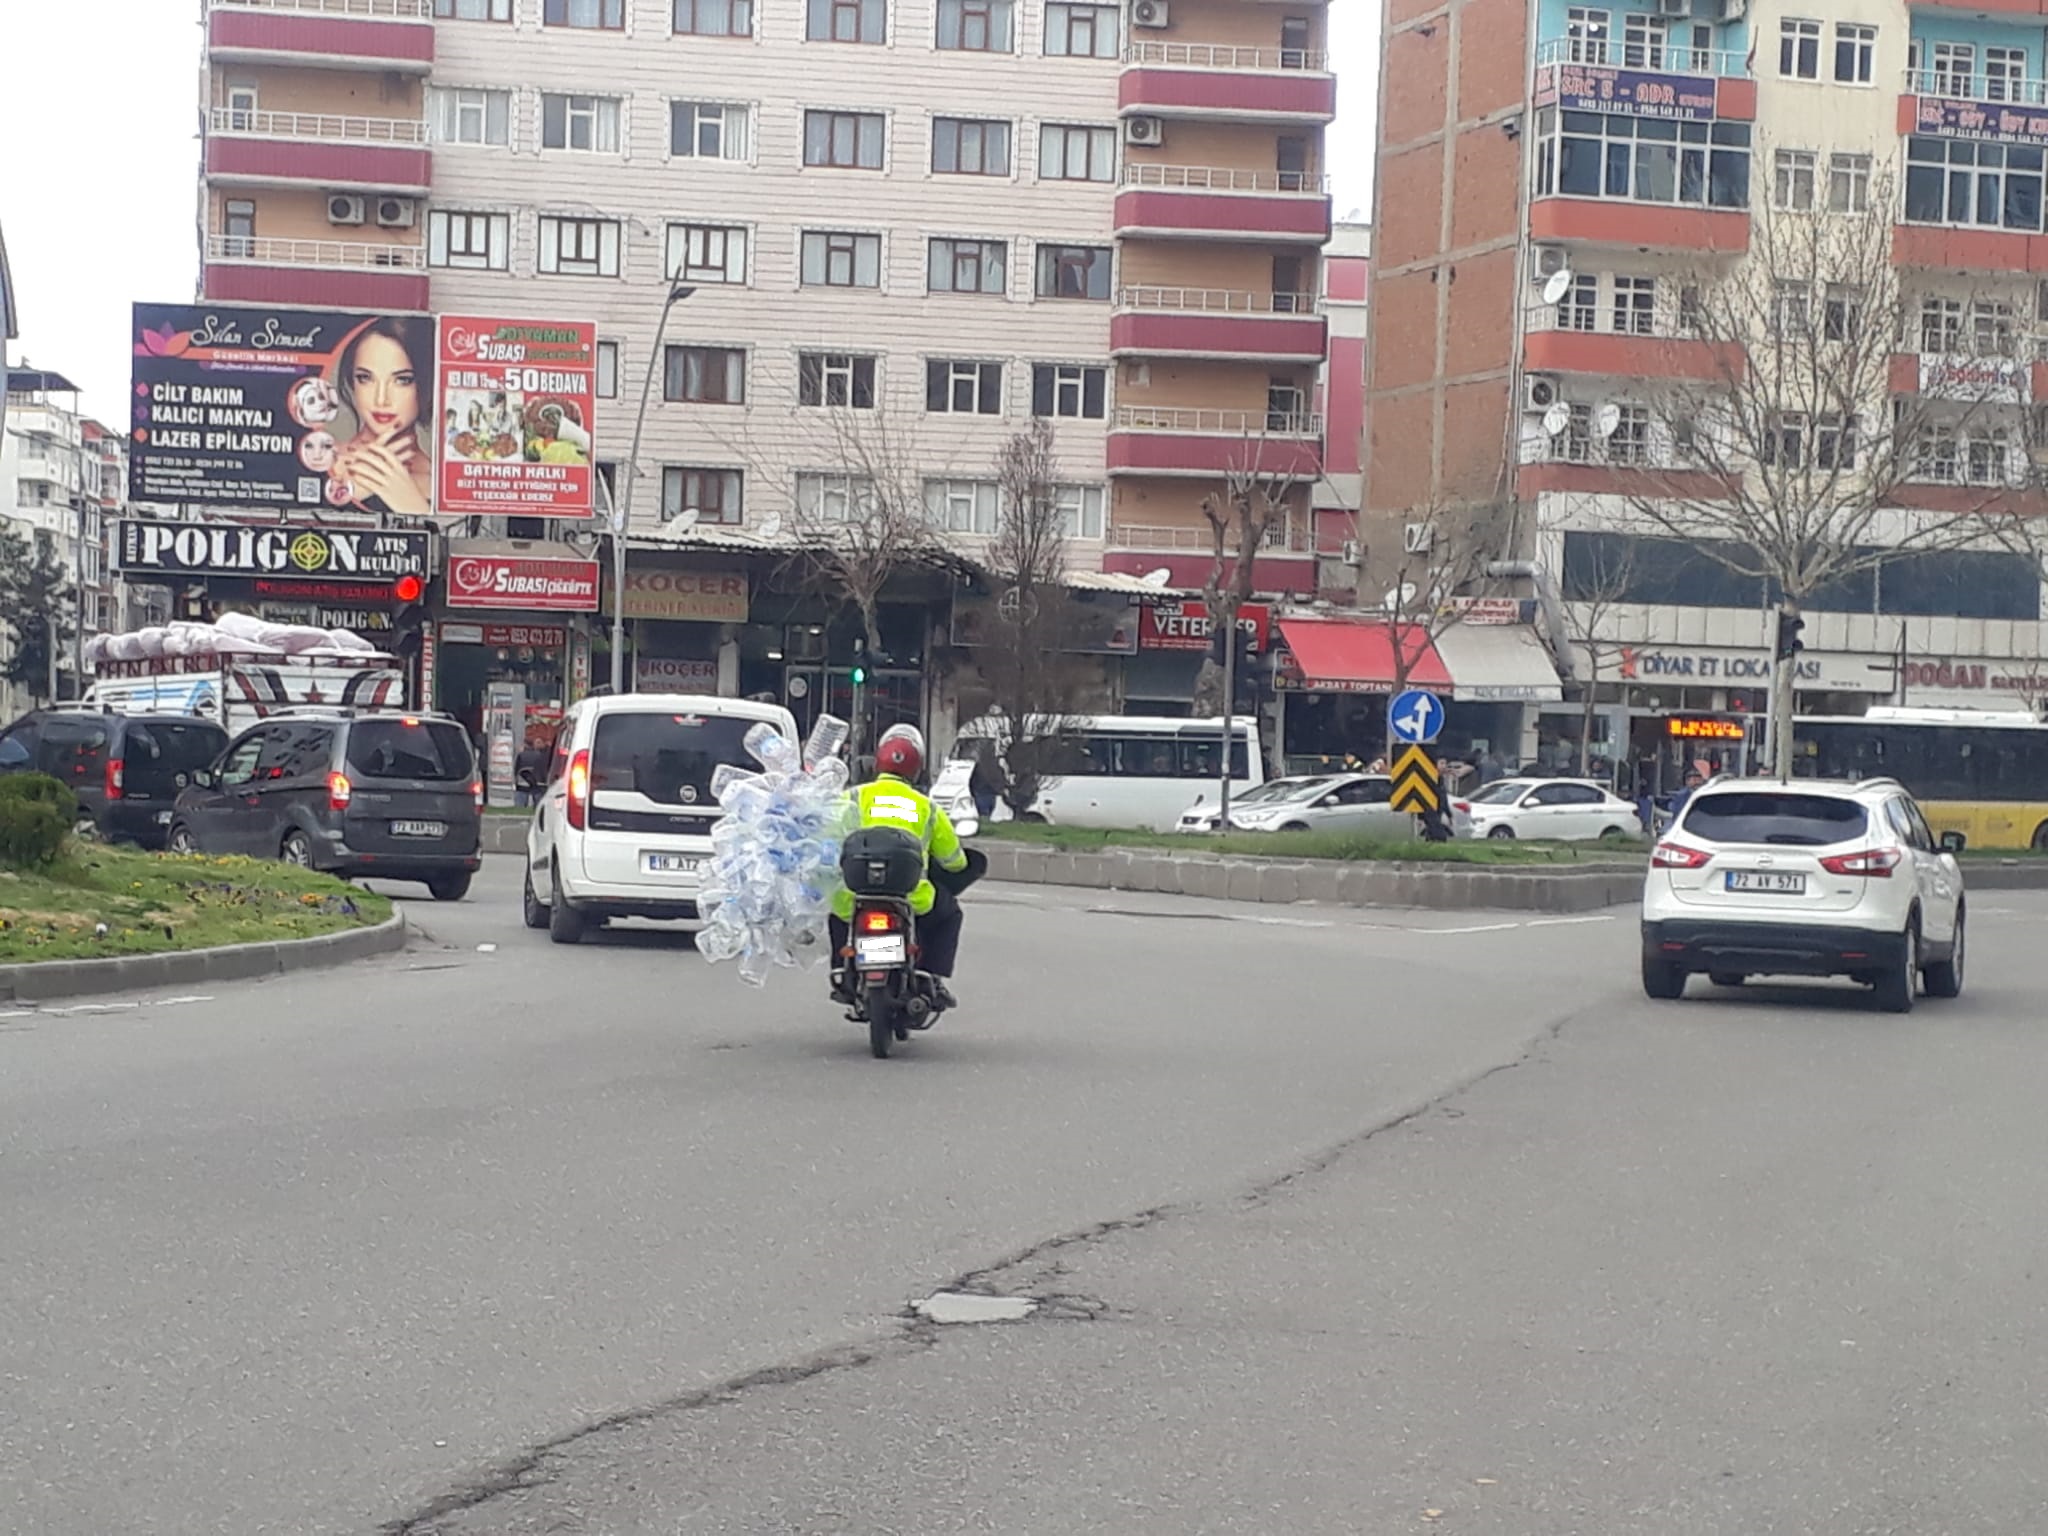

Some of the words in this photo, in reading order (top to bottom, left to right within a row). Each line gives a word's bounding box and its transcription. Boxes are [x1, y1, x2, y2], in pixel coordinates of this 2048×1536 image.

[504, 367, 539, 392] 50
[540, 372, 587, 394] BEDAVA
[153, 382, 186, 401] CİLT
[191, 385, 243, 406] BAKIM
[151, 404, 204, 425] KALICI
[209, 407, 273, 428] MAKYAJ
[150, 429, 200, 449] LAZER
[205, 430, 292, 453] EPİLASYON
[463, 463, 521, 478] BATMAN
[1643, 652, 1693, 676] DİYAR
[1699, 658, 1718, 676] ET
[1724, 658, 1820, 679] LOKAASI
[1735, 874, 1749, 887] 72
[1778, 875, 1799, 889] 571
